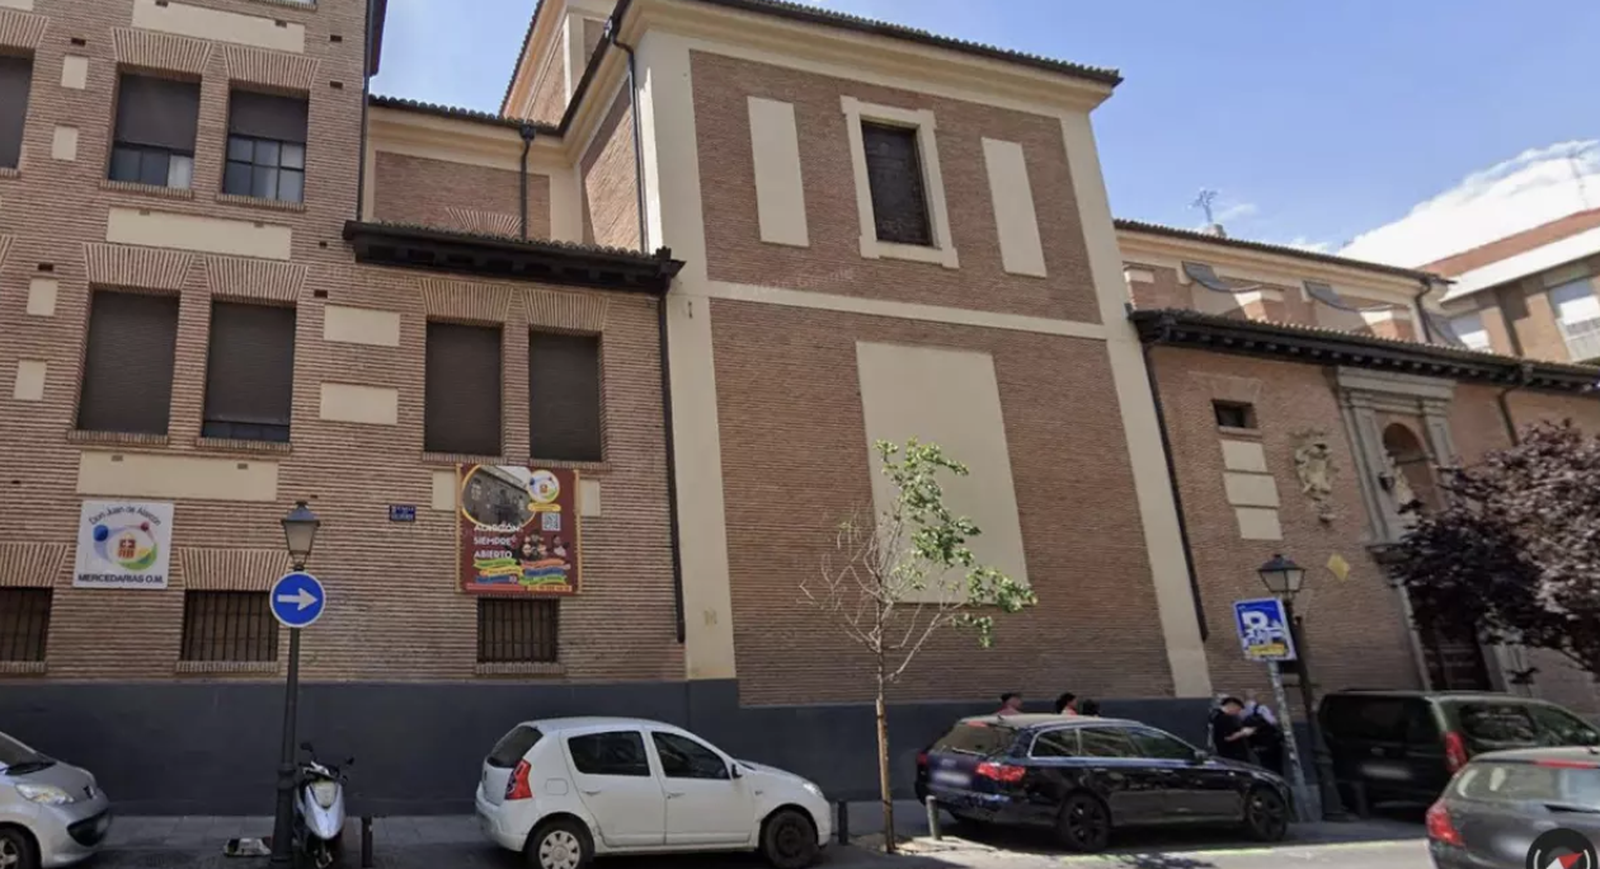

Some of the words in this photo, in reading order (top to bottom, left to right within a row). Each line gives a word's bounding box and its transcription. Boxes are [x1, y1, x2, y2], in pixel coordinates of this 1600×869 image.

[89, 511, 106, 525] Don
[106, 506, 125, 516] Juan
[474, 550, 512, 559] ABIERTO
[78, 573, 144, 583] MERCEDARIAS
